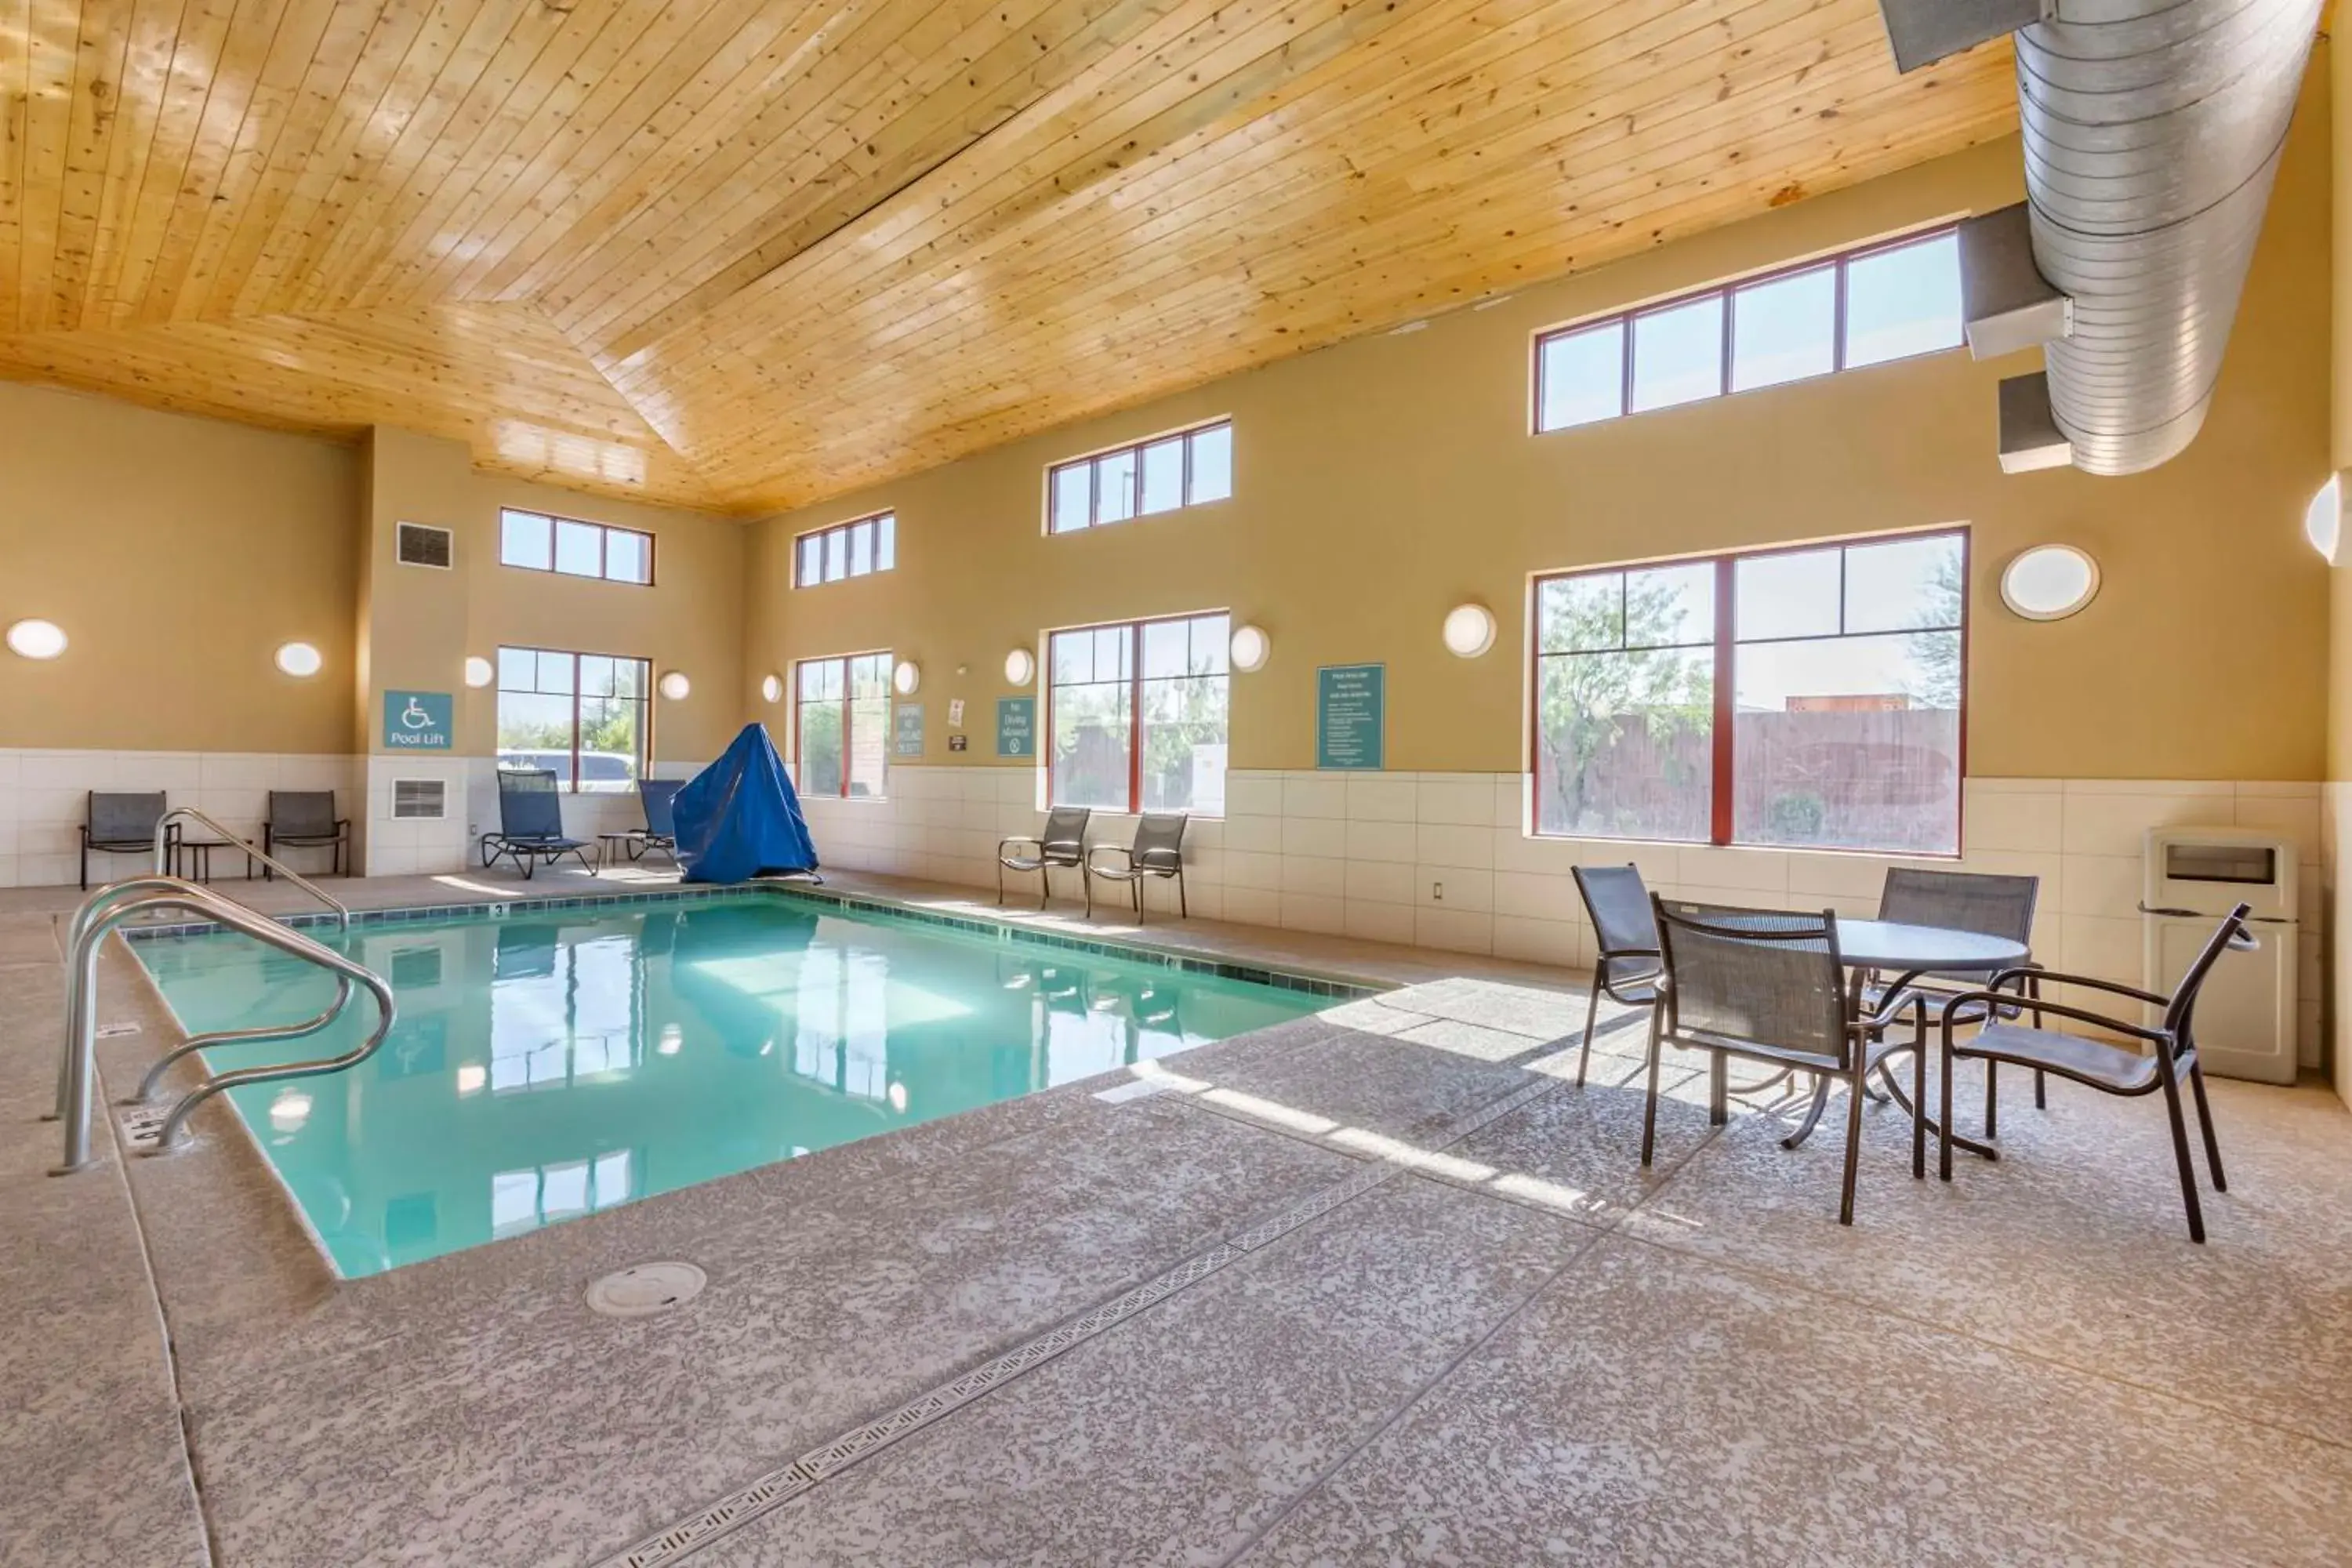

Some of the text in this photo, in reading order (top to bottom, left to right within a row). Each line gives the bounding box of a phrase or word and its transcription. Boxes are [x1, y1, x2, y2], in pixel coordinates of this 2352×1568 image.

[1004, 714, 1027, 726] Diving
[391, 732, 444, 744] Pool Lift
[495, 904, 503, 916] 3
